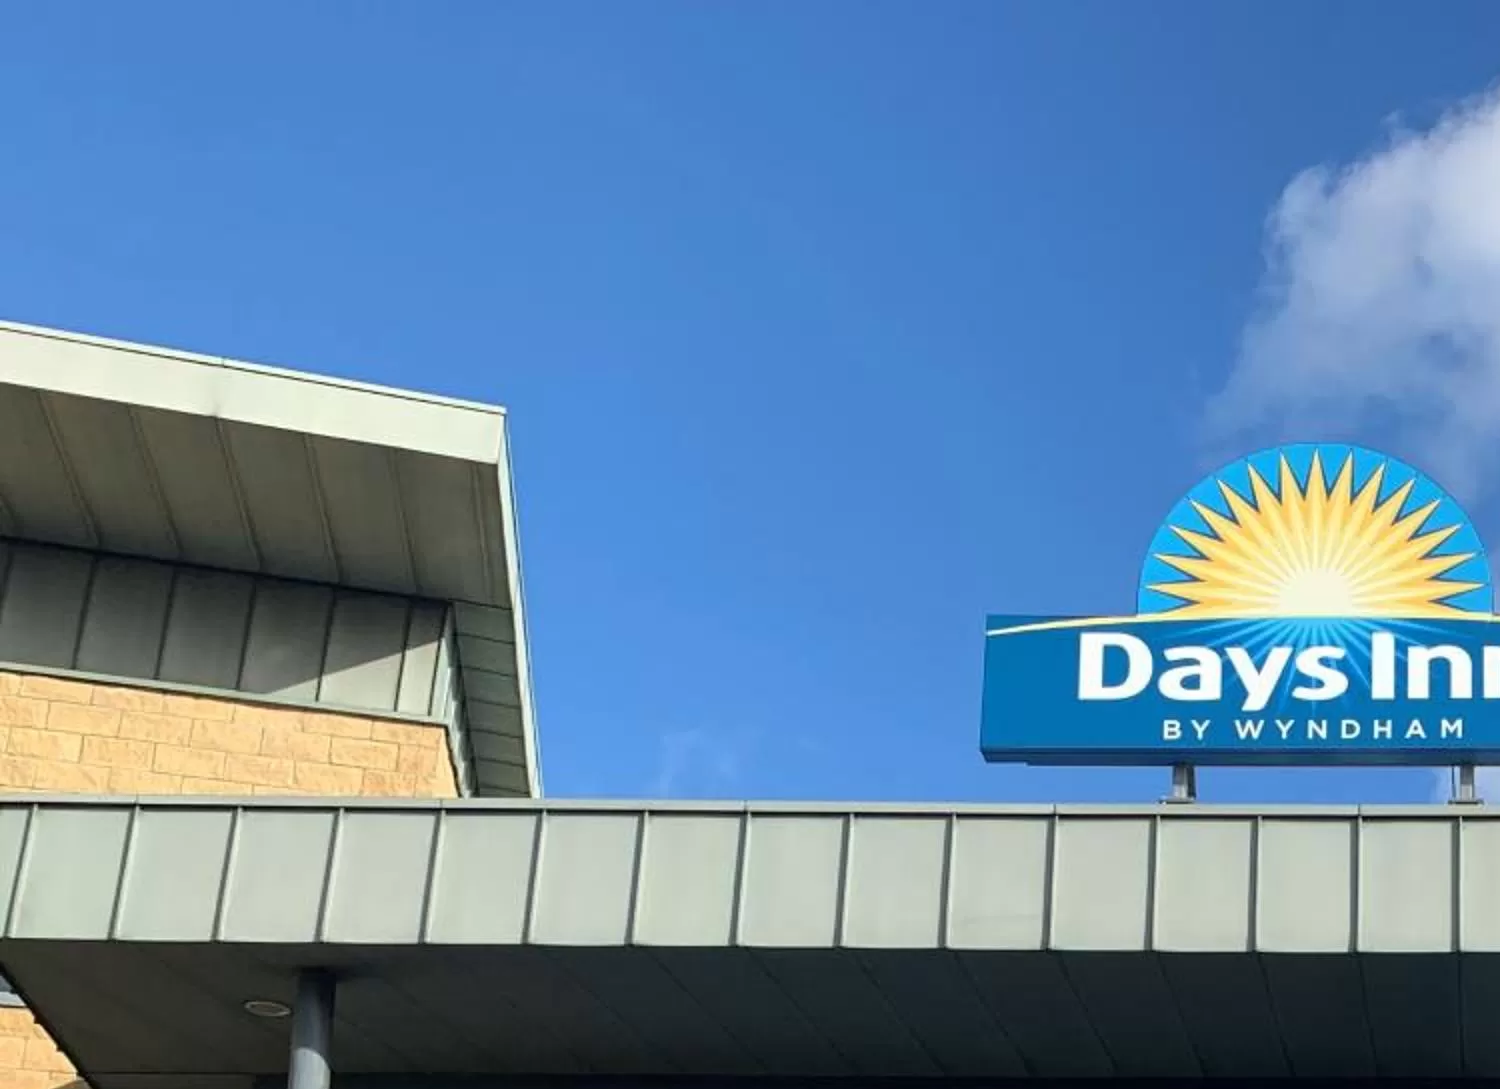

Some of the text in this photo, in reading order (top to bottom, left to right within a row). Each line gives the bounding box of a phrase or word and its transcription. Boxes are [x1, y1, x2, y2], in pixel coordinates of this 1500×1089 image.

[1078, 632, 1349, 711] Days
[1162, 719, 1465, 741] BY WYNDHAM
